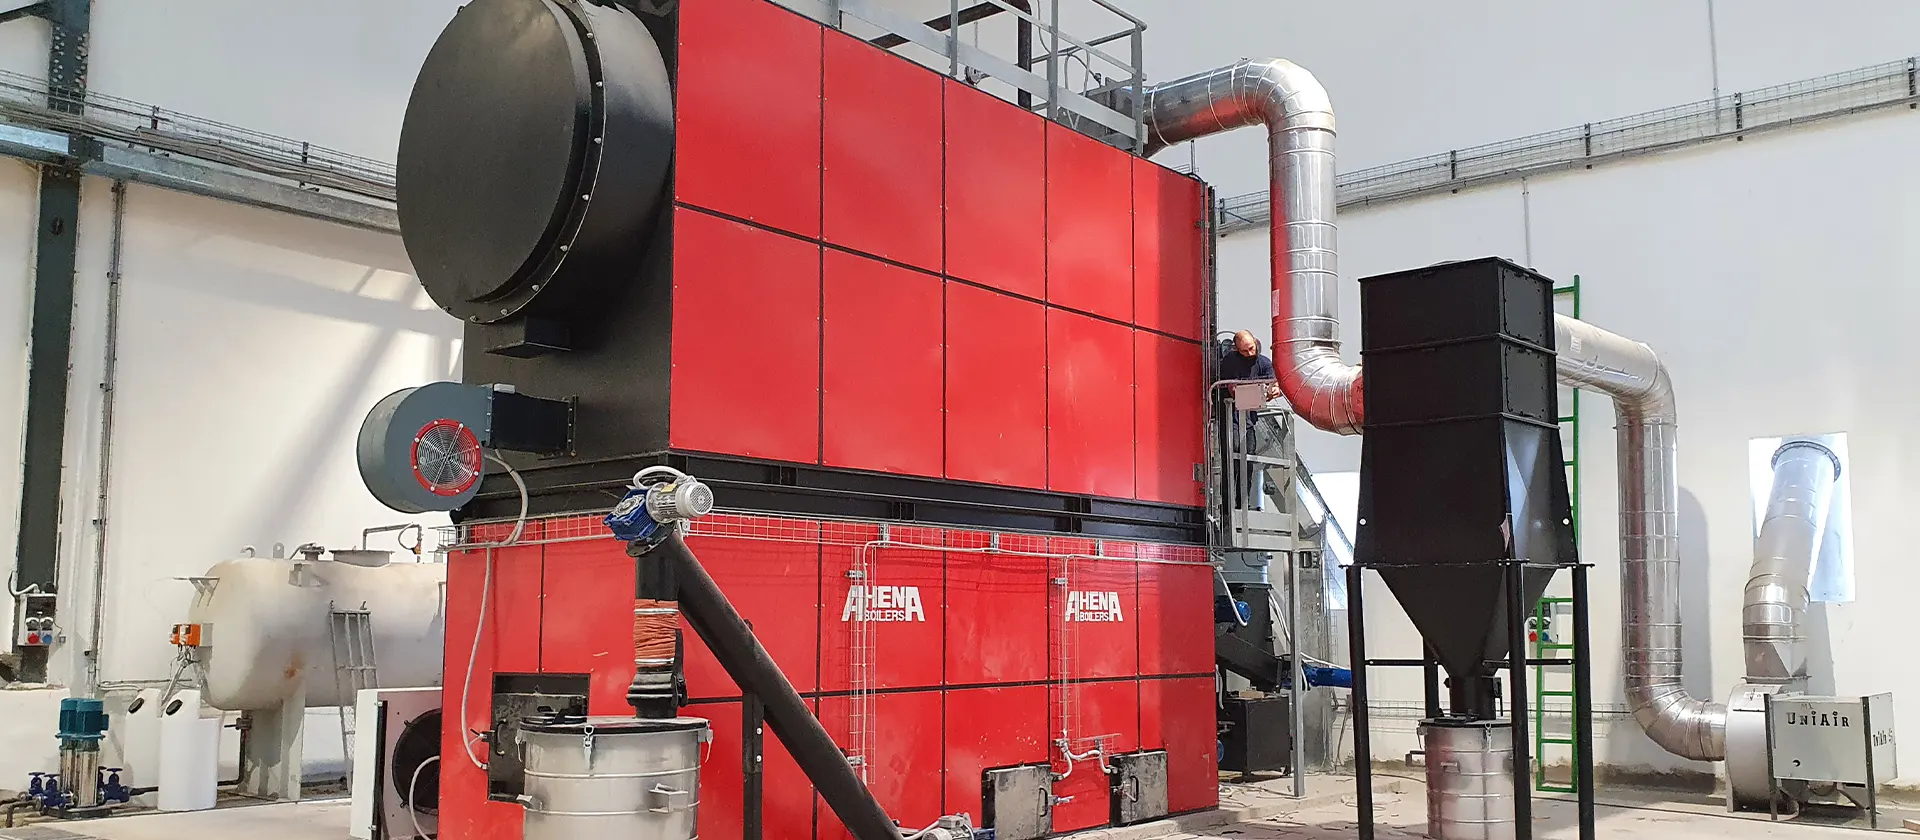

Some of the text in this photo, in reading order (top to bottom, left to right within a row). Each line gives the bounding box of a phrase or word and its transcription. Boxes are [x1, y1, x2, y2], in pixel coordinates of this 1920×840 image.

[841, 585, 925, 622] AHENA
[1065, 590, 1124, 622] AHENA
[865, 610, 905, 622] BOILERS
[1080, 611, 1109, 622] BOILERS
